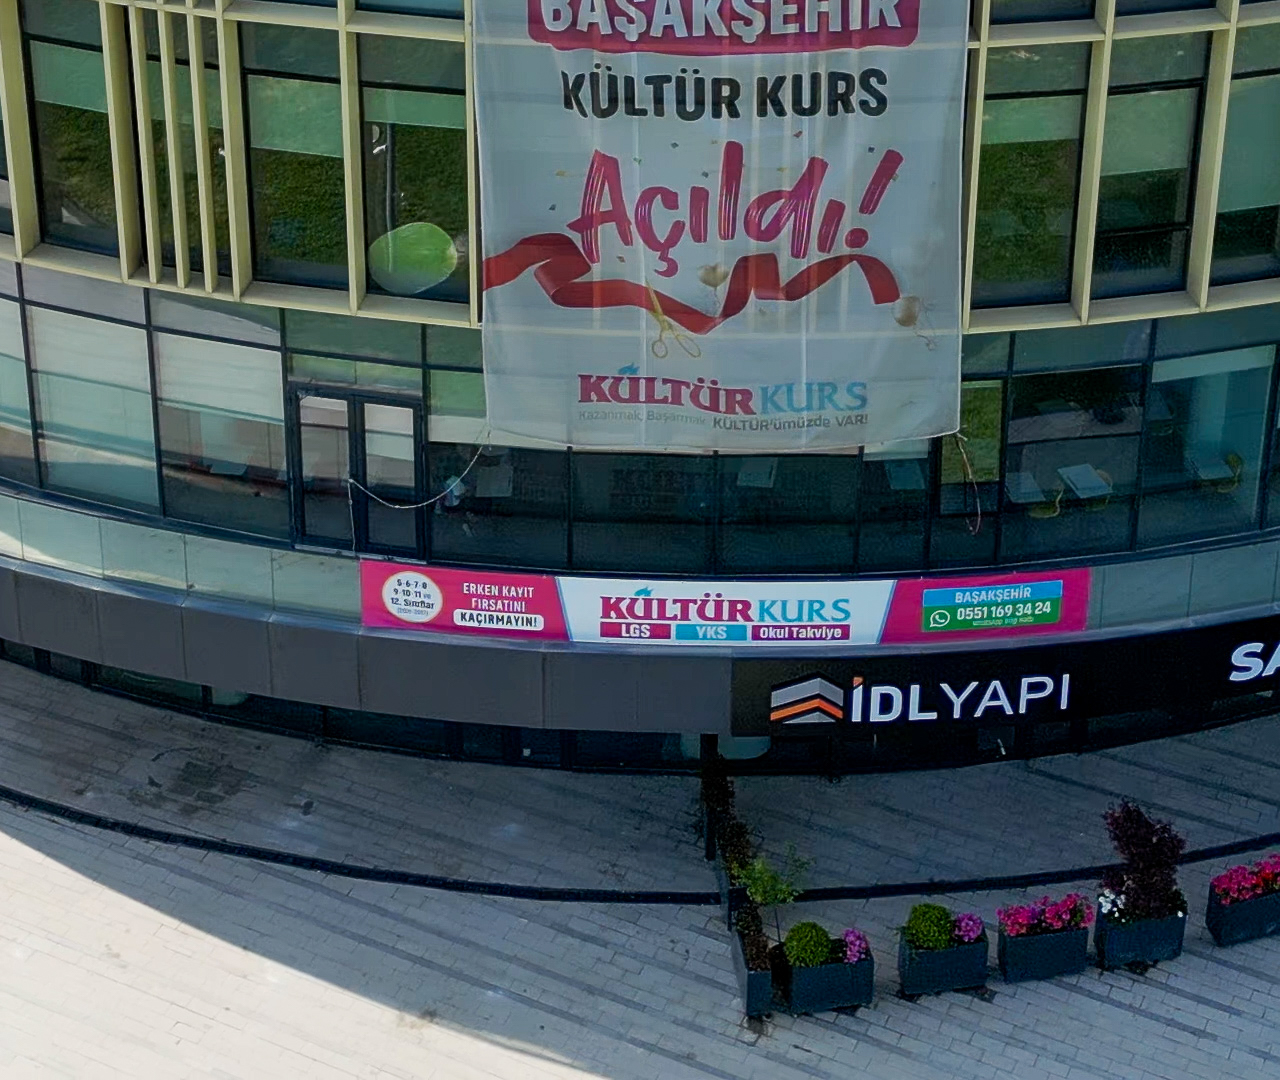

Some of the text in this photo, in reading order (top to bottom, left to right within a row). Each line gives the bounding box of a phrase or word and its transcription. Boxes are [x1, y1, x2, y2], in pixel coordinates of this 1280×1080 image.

[561, 62, 889, 121] KÜLTÜR KURS
[566, 140, 904, 278] Açıldı!
[835, 414, 869, 427] VAR!
[463, 582, 535, 598] ERKEN KAYIT
[955, 586, 1032, 604] BAŞAKŞEHİR
[471, 597, 526, 612] FIRSATINI
[956, 601, 1052, 621] 0551 169 34 24
[460, 612, 538, 628] KAÇIRMAYIN!
[621, 624, 651, 638] LGS
[695, 625, 727, 639] YKS
[760, 626, 842, 640] Okul Takviye
